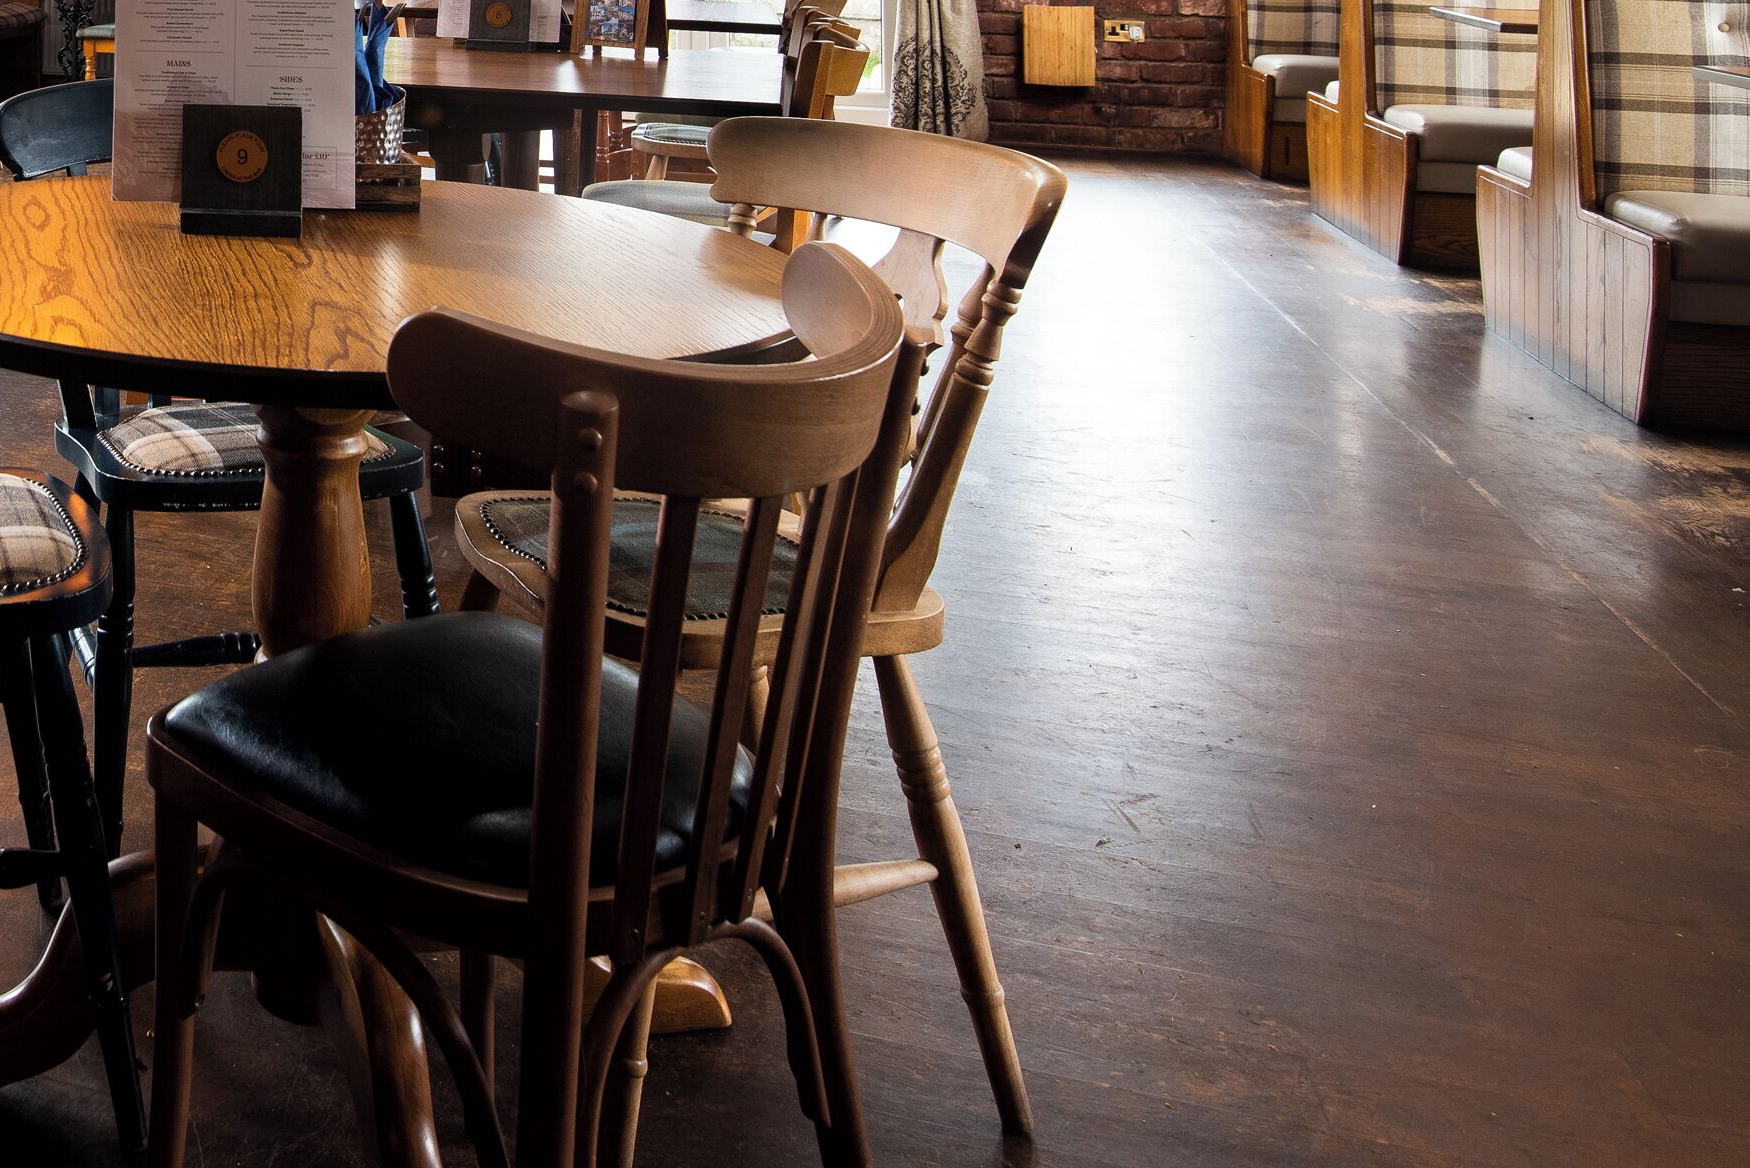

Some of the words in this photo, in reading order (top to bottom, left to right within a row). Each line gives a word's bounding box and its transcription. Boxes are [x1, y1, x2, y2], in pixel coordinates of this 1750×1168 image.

[166, 60, 192, 68] MAINS
[279, 75, 304, 84] SIDES
[237, 148, 248, 165] 9
